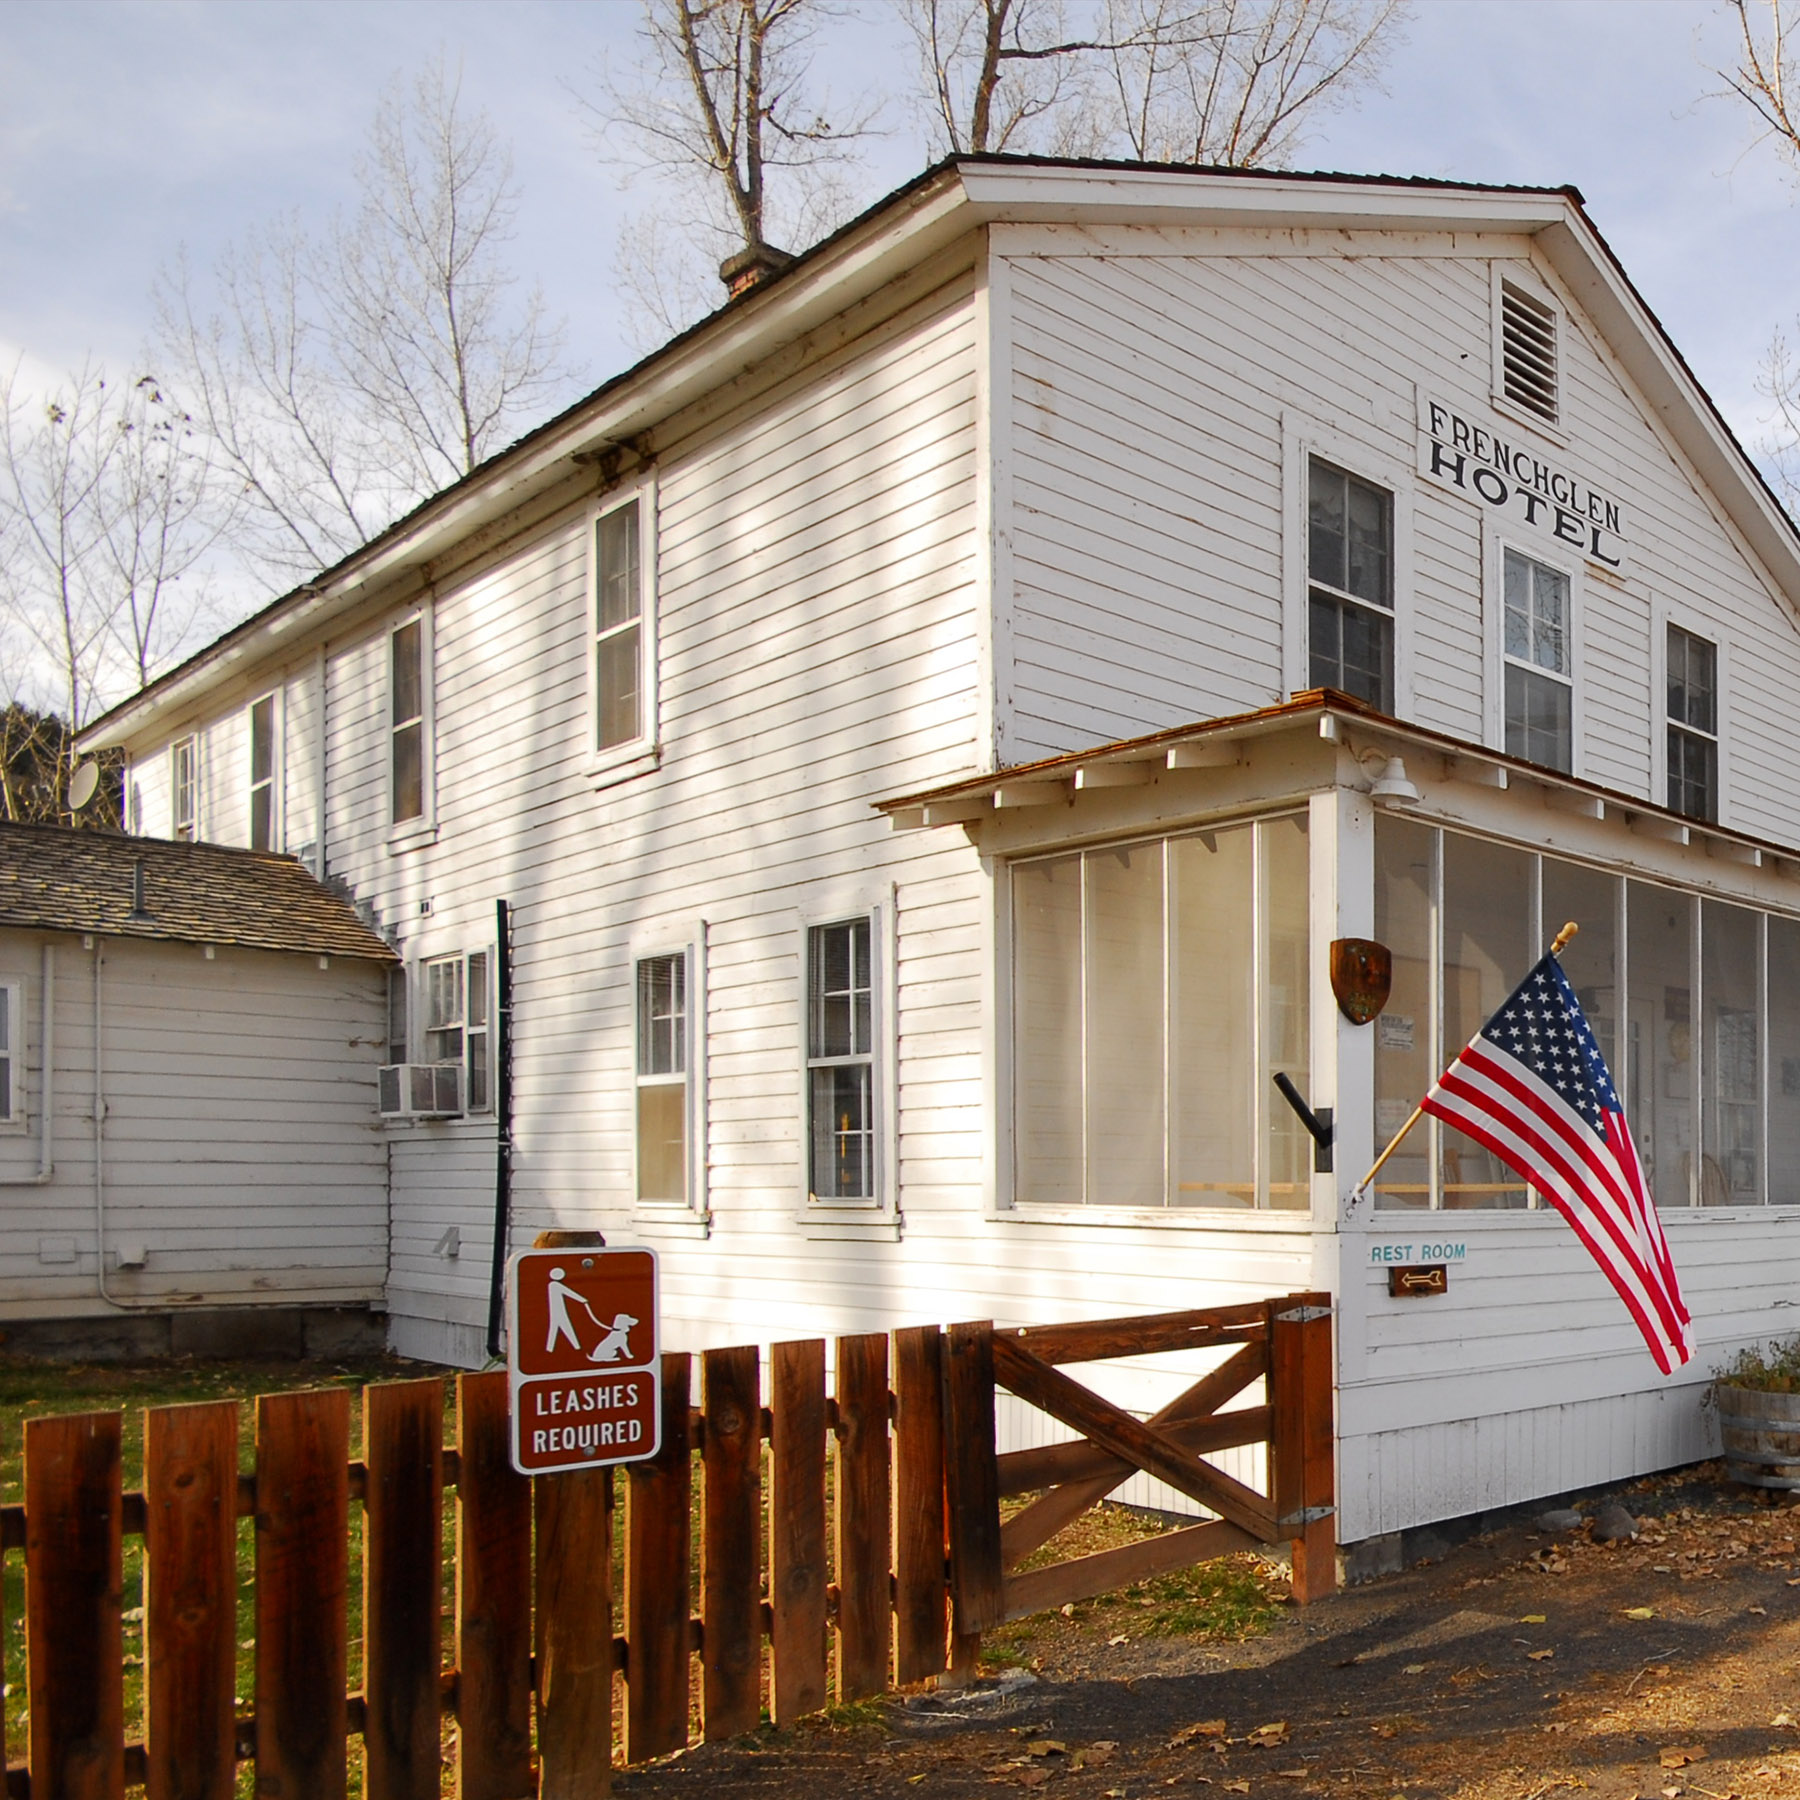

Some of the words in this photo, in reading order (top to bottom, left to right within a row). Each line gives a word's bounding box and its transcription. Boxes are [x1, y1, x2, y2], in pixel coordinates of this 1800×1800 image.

[1429, 401, 1620, 534] FRENCHGLEN
[1430, 439, 1620, 567] HOTEL
[1372, 1245, 1412, 1262] REST
[1422, 1243, 1465, 1260] ROOM
[536, 1384, 638, 1416] LEASHES
[533, 1419, 641, 1453] REQUIRED
